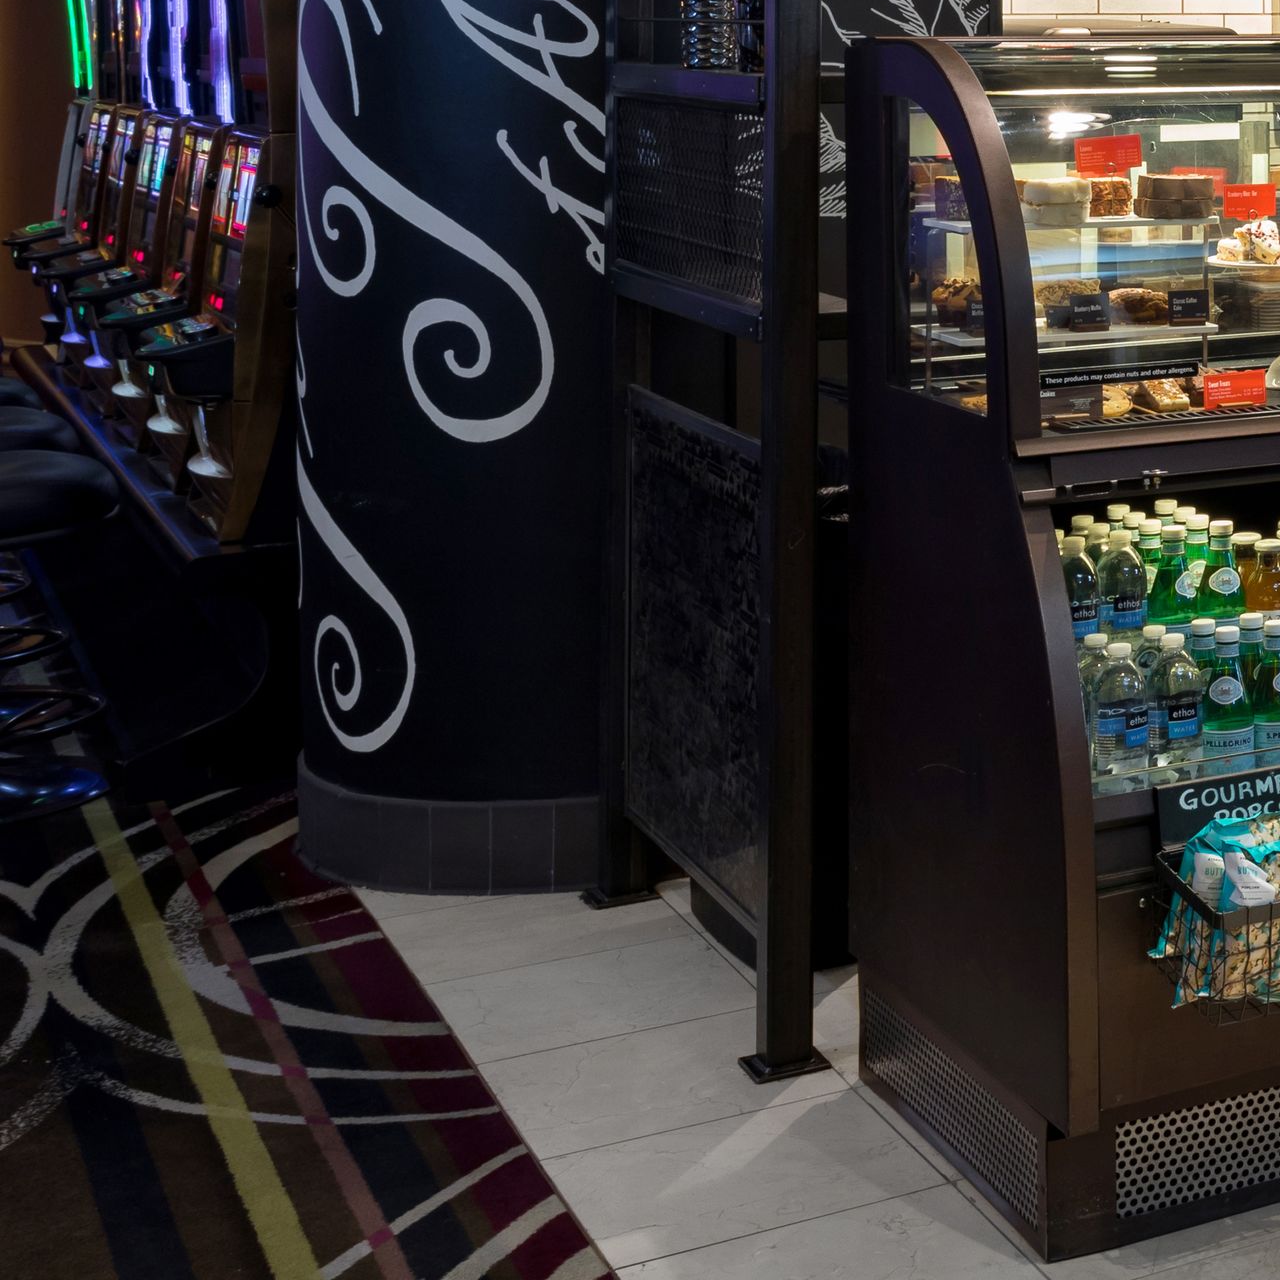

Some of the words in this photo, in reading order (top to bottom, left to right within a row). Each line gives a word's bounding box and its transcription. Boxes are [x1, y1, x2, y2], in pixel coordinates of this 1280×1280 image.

[1046, 376, 1062, 384] These
[1064, 374, 1089, 384] products
[1090, 374, 1102, 382] may
[1104, 370, 1125, 379] contain
[1126, 370, 1139, 378] nuts
[1152, 368, 1167, 376] other
[1168, 366, 1194, 375] allergens.
[1118, 600, 1140, 609] ethos
[1074, 609, 1096, 619] ethos
[1172, 707, 1196, 719] ethos
